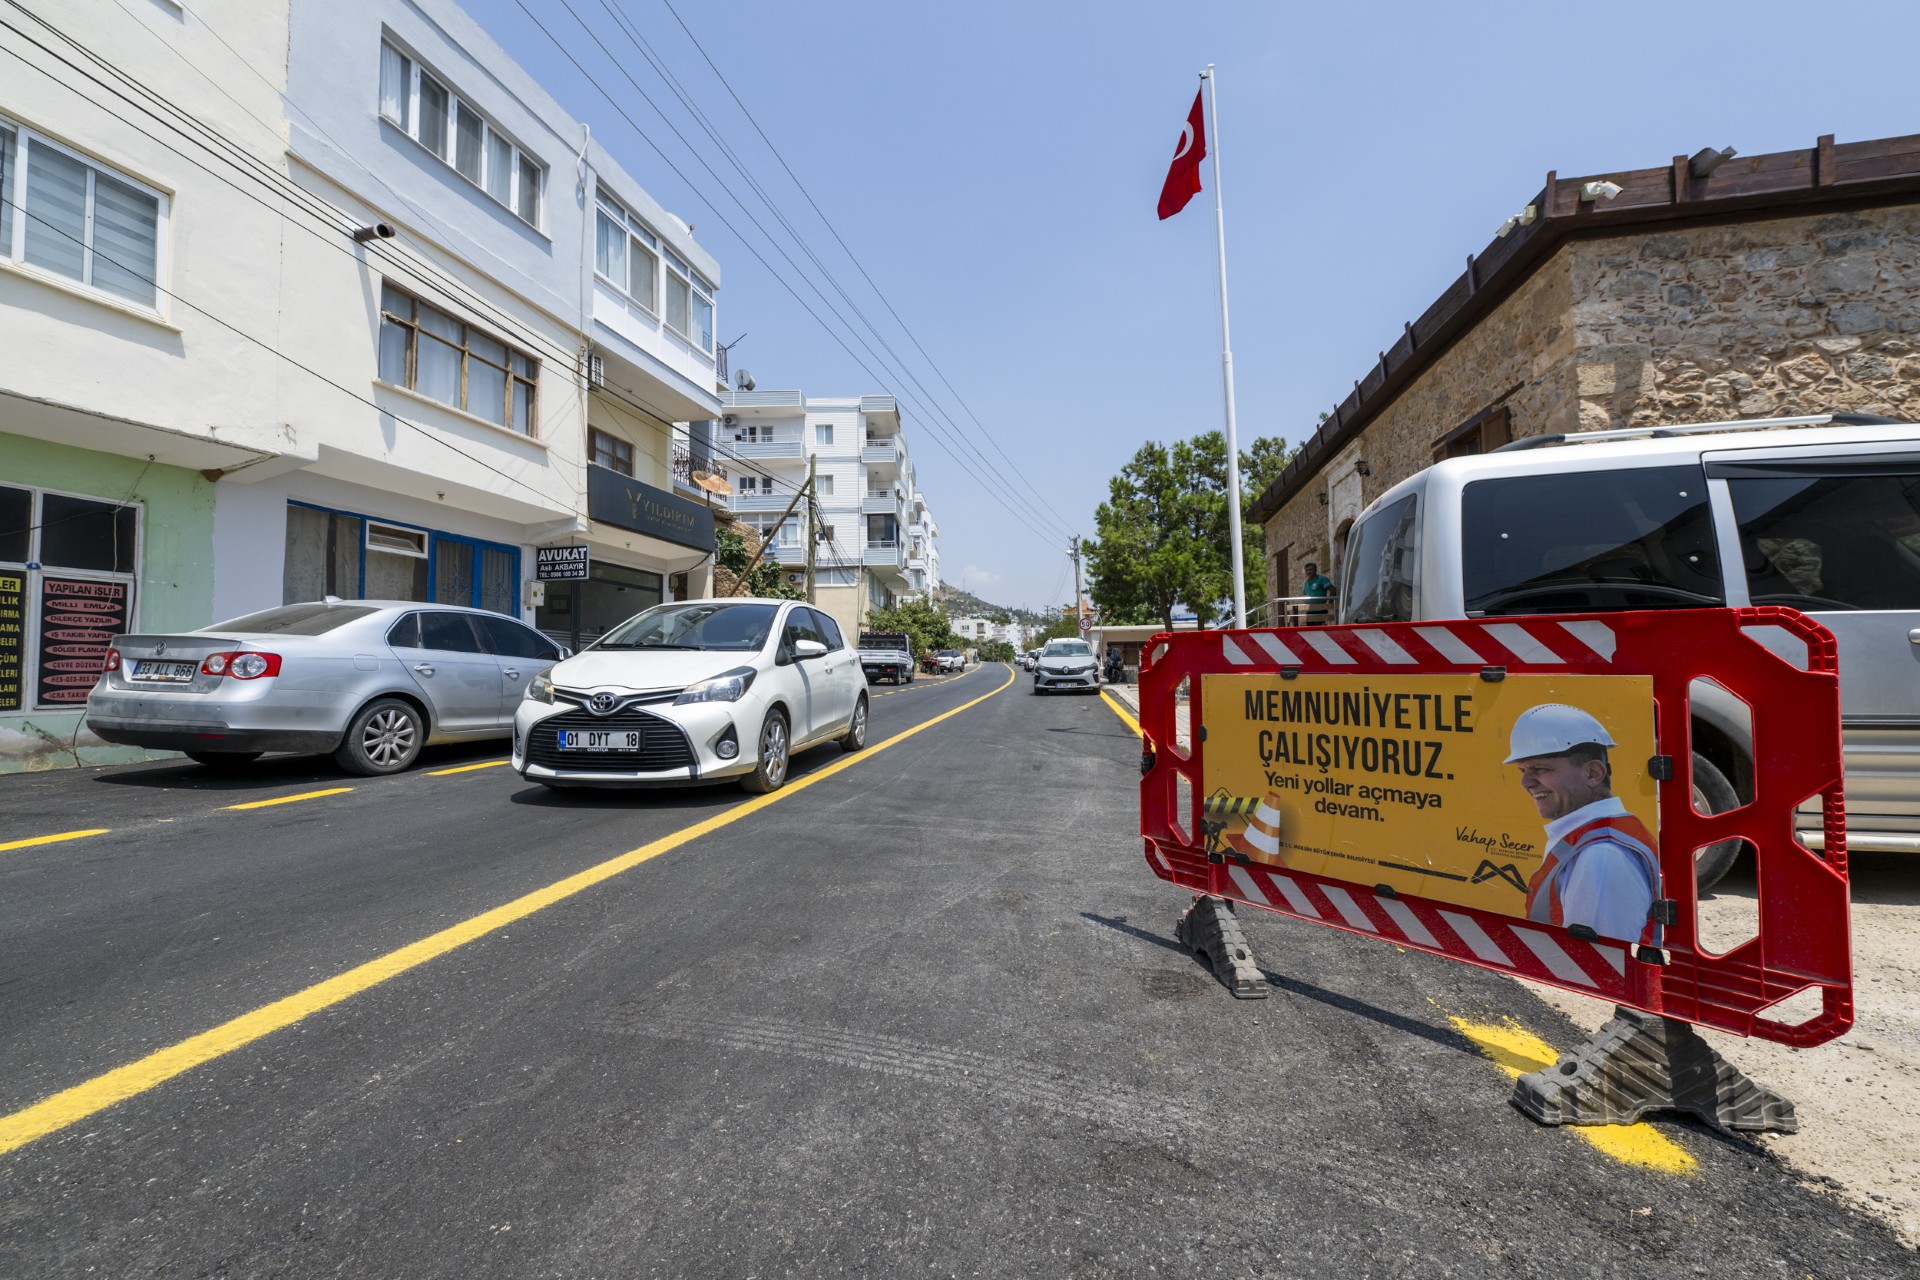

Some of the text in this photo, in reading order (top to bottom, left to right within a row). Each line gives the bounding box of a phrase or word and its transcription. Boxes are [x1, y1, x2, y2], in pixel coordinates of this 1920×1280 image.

[642, 498, 695, 527] YILDIRIM
[538, 547, 587, 561] AVUKAT
[48, 583, 92, 594] YAPILAN
[140, 663, 152, 675] 33
[153, 664, 170, 676] ALL
[173, 665, 193, 678] 866
[1245, 686, 1474, 733] MEMNUNİYETLE
[567, 732, 579, 746] 01
[589, 732, 610, 747] DYT
[626, 732, 637, 747] 18
[1259, 730, 1455, 780] ÇALIŞIYORUZ.
[1265, 771, 1442, 810] Yeni yollar açmaya
[1314, 797, 1385, 822] devam.
[1456, 821, 1497, 853] Vahap
